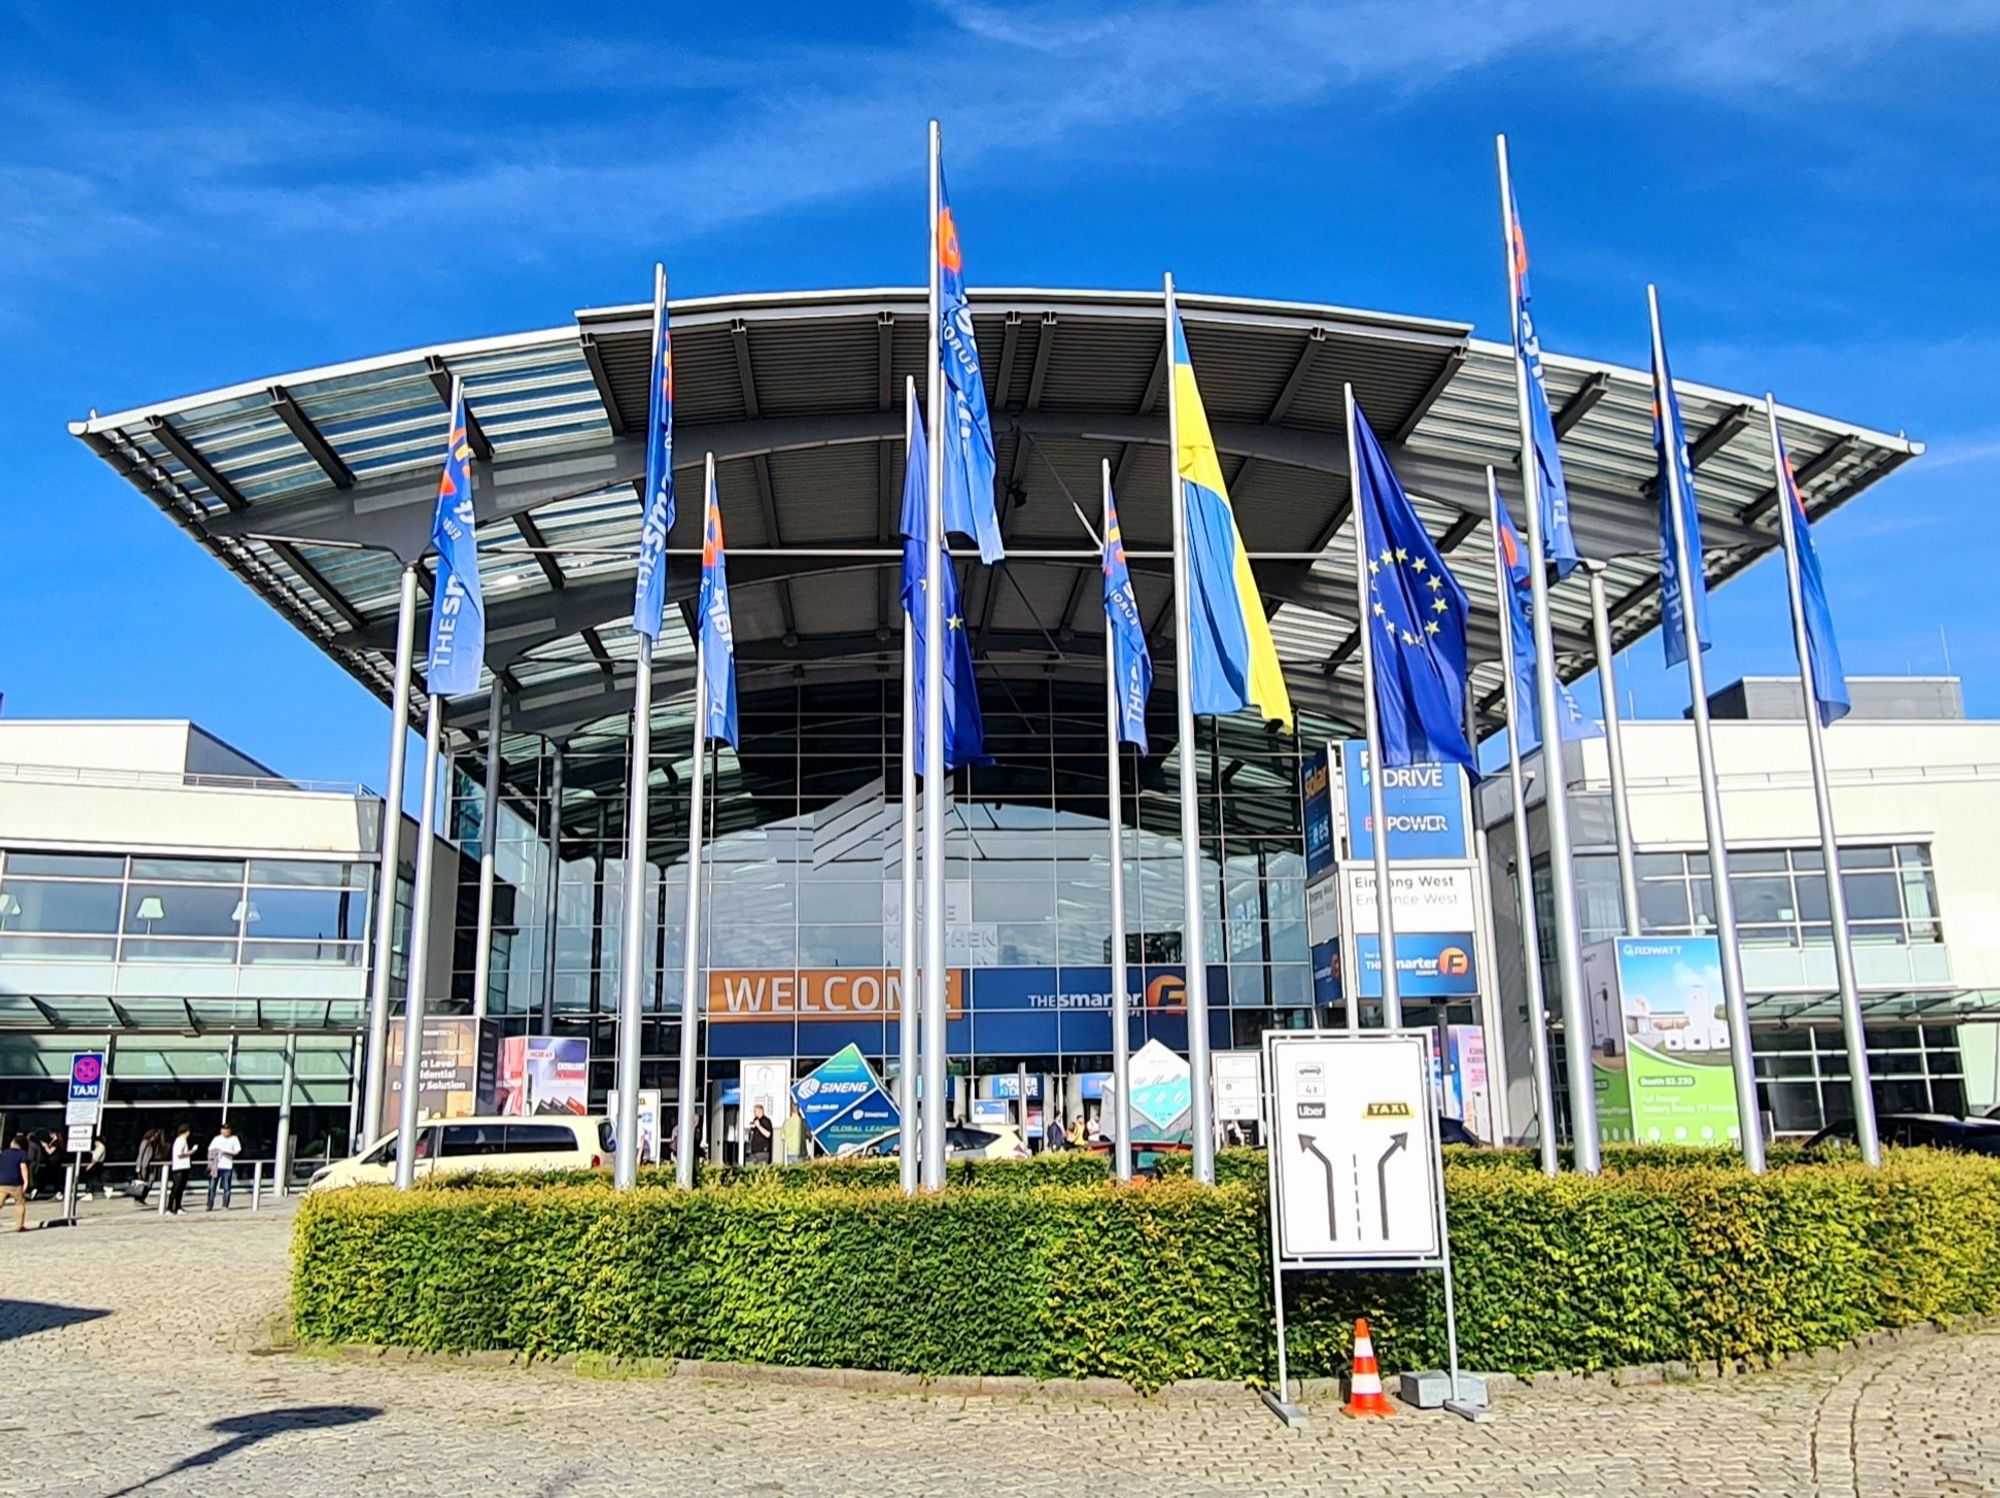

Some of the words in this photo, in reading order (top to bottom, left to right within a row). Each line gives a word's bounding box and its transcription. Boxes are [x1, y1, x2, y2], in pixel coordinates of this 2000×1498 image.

[1383, 769, 1443, 787] DRIVE
[1419, 876, 1454, 888] West
[1424, 893, 1458, 905] West
[1624, 944, 1682, 956] GROWATT
[430, 1060, 455, 1068] Level
[73, 1085, 98, 1096] TAXI
[427, 1082, 466, 1090] Solution
[820, 1081, 869, 1094] SINENG
[1298, 1104, 1323, 1117] Uber
[1370, 1104, 1407, 1114] TAXI
